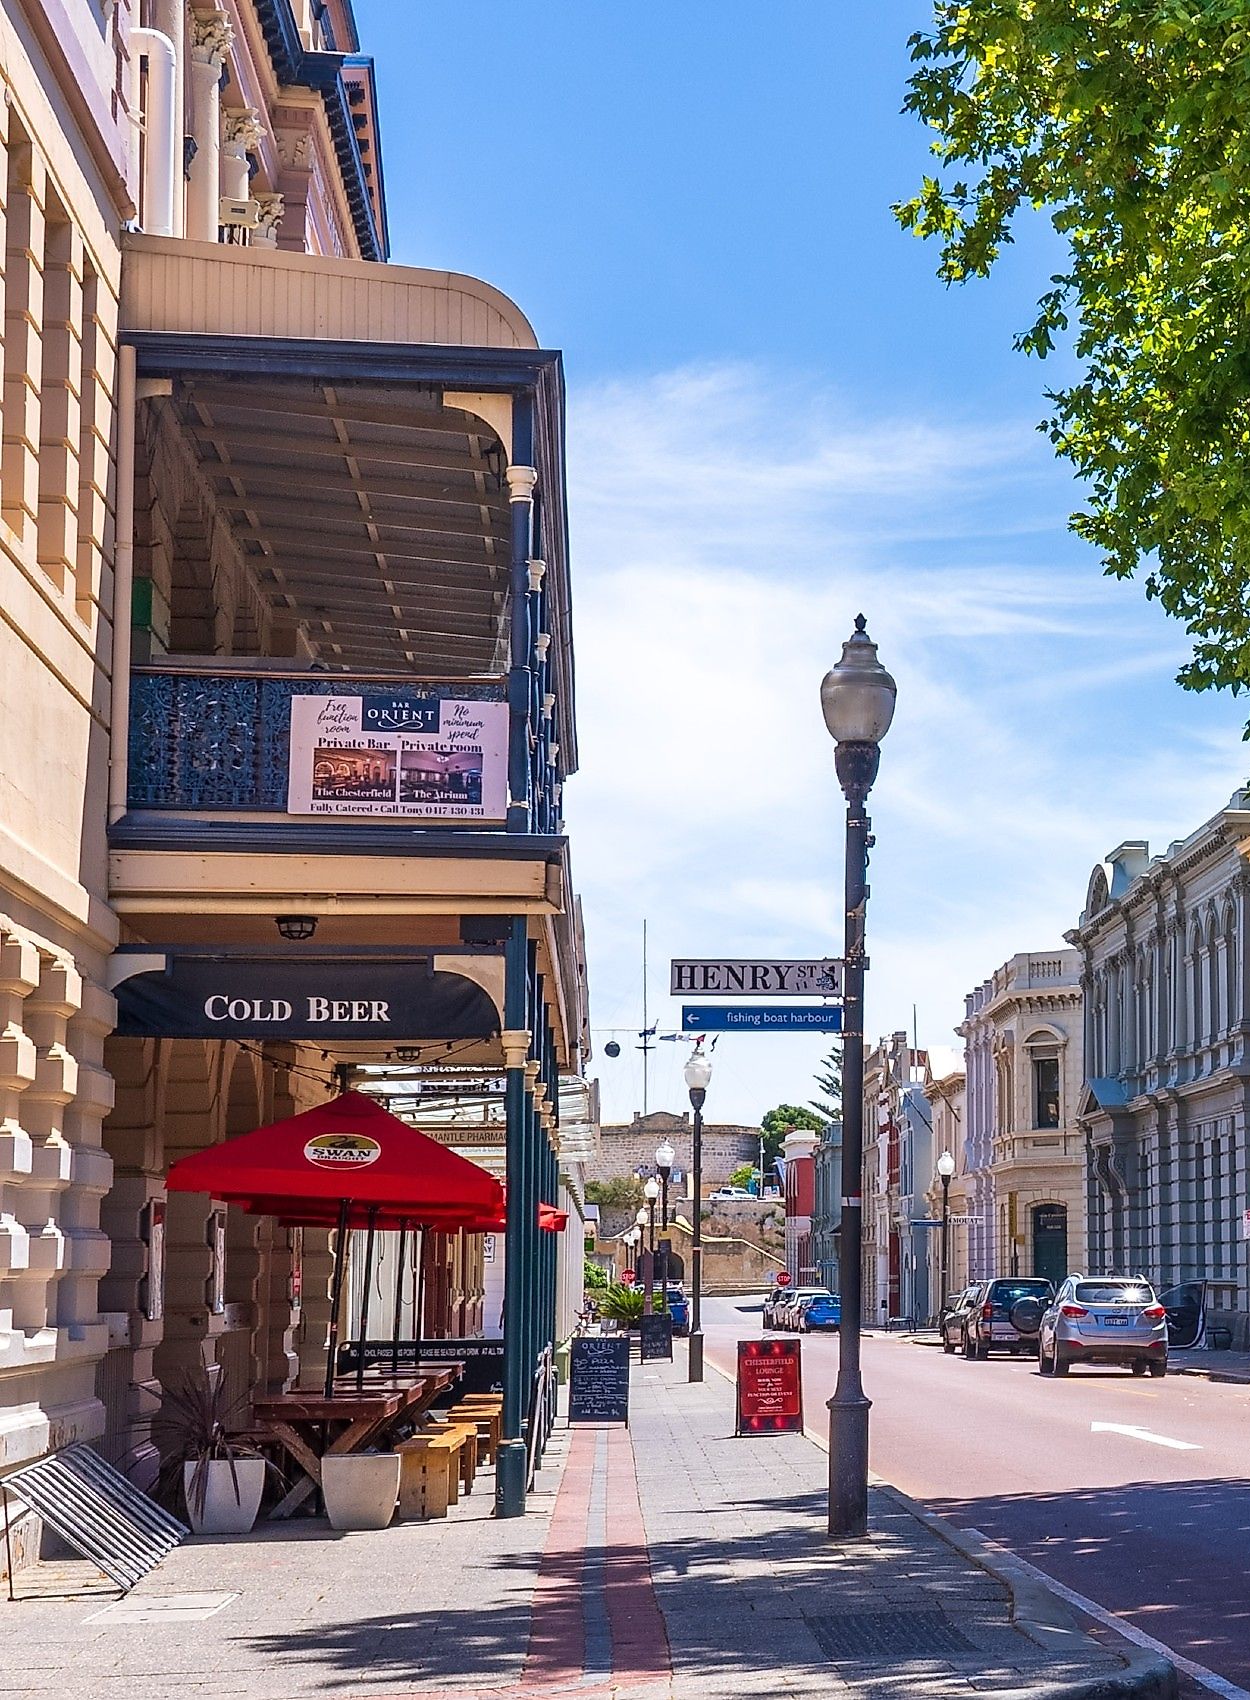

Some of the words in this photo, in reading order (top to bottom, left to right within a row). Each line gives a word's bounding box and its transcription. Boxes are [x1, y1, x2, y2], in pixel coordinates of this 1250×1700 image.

[325, 699, 347, 711] Free
[454, 704, 470, 717] No
[317, 709, 359, 725] function
[368, 709, 434, 721] ORIENT
[443, 716, 485, 728] minimum
[325, 725, 351, 733] room
[447, 728, 480, 743] spend
[318, 737, 364, 748] Private
[367, 739, 391, 749] Bar
[401, 740, 447, 751] Private
[450, 744, 482, 752] room
[315, 787, 334, 797] The
[335, 788, 392, 798] Chesterfield
[413, 789, 432, 799] The
[433, 790, 468, 800] Atrium
[310, 803, 334, 815] Fully
[335, 804, 373, 813] Catered
[380, 804, 399, 814] Call
[400, 805, 423, 816] Tony
[674, 964, 795, 990] HENRY
[797, 965, 817, 978] ST
[204, 995, 293, 1021] COLD
[306, 996, 391, 1022] BEER
[727, 1012, 761, 1026] fishing
[763, 1012, 788, 1023] boat
[790, 1012, 834, 1023] harbour
[312, 1148, 372, 1157] SWAN
[582, 1342, 621, 1350] ORIENT
[744, 1358, 794, 1366] CHESTERFIELD
